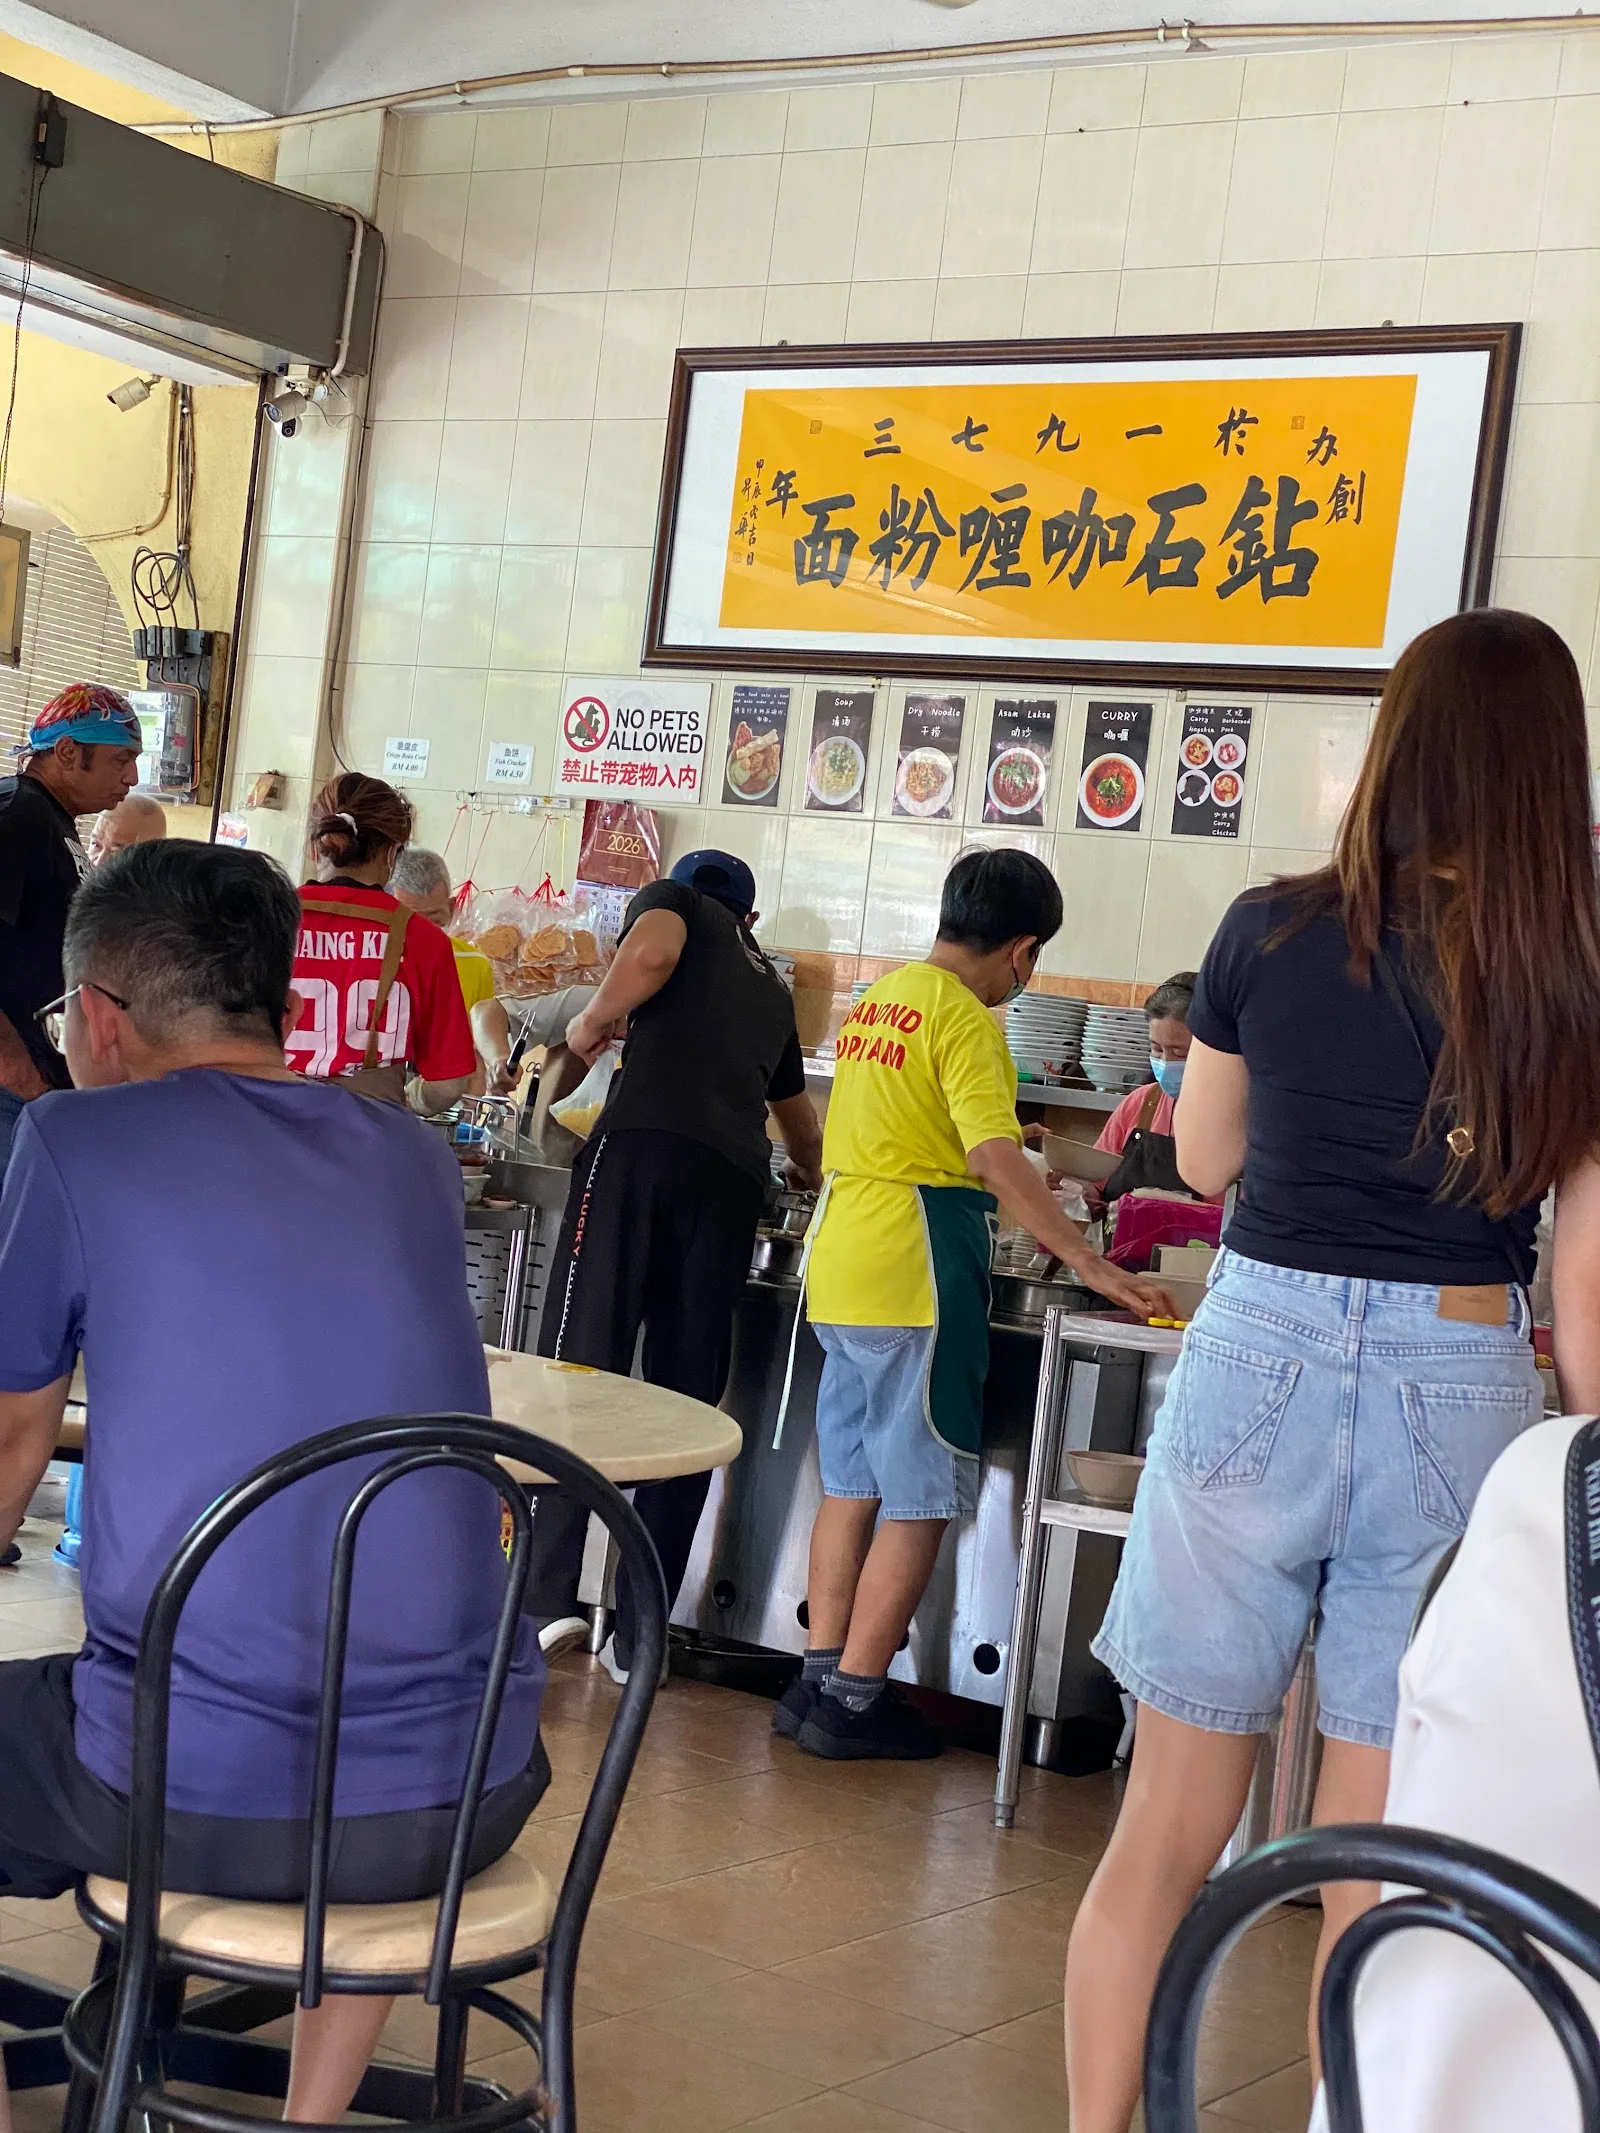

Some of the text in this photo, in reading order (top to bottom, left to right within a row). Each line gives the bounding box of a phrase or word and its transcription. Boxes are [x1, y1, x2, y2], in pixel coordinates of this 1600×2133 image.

[834, 698, 853, 707] Soup
[907, 706, 961, 717] Dry Noodle
[997, 708, 1051, 719] Asam Laksa
[1101, 710, 1139, 722] CURRY
[616, 708, 700, 731] NO PETS
[606, 730, 703, 754] ALLOWED
[391, 762, 404, 771] RM
[495, 768, 524, 778] RM 4.50
[561, 758, 697, 790] 禁止带宠物入内
[606, 834, 641, 855] 2026
[613, 904, 621, 912] 16
[611, 926, 619, 934] 18
[573, 1192, 591, 1257] LUCKY
